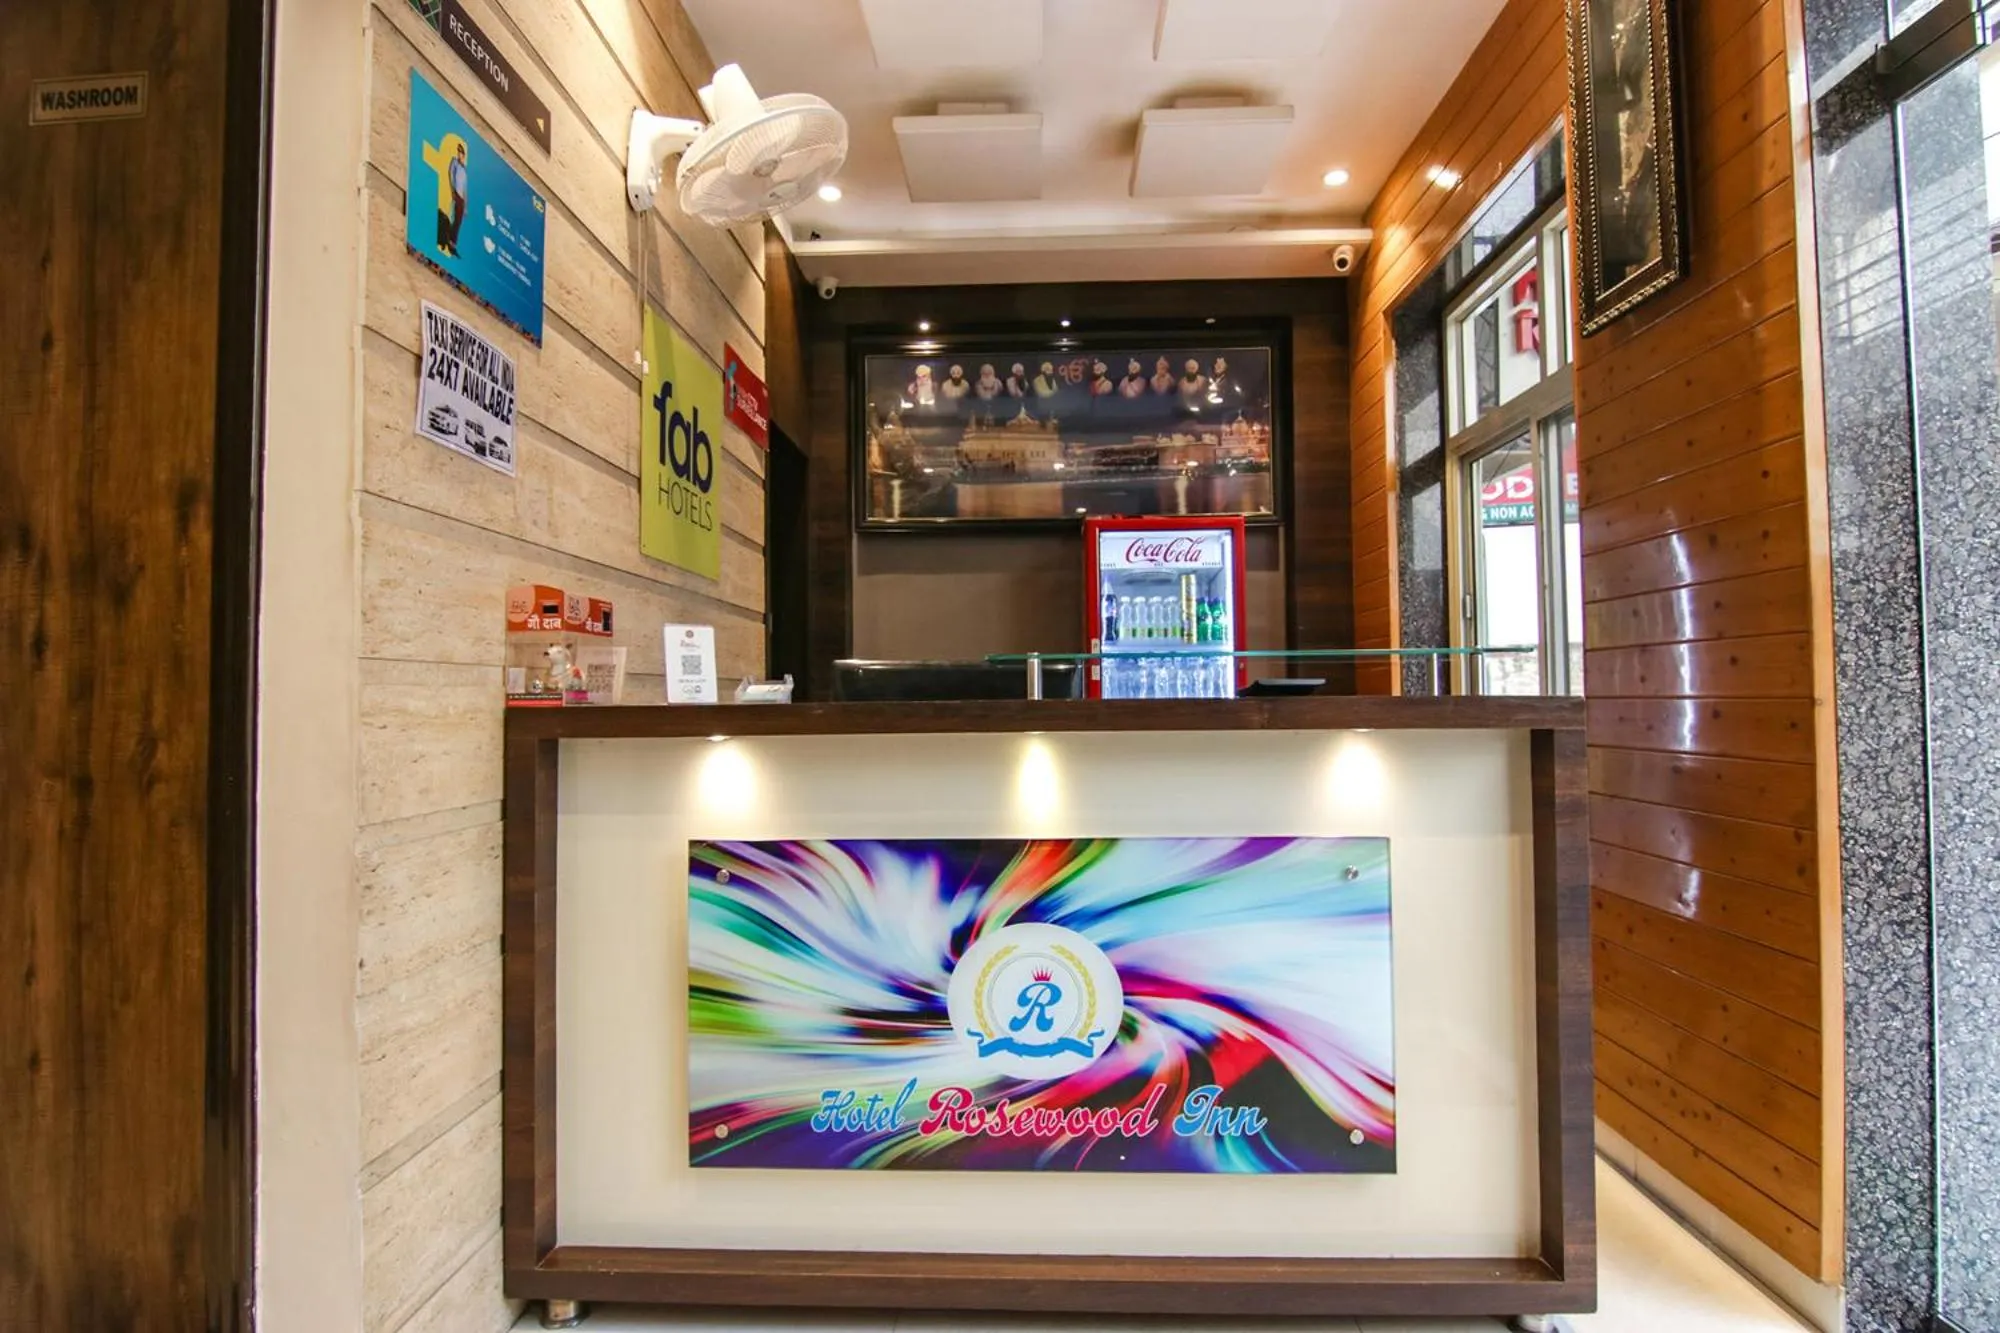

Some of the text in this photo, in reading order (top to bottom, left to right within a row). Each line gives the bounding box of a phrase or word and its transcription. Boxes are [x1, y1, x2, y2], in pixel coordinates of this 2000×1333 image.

[449, 13, 509, 92] RECEPTION
[42, 85, 138, 112] WASHROOM
[427, 311, 449, 351] TAXI
[450, 322, 477, 369] SERVICE
[475, 341, 489, 378] FOR
[427, 347, 514, 426] 24X7 AVAILABLE
[653, 381, 713, 493] fab
[658, 472, 712, 532] HOTELS
[1490, 506, 1517, 519] NON
[811, 1077, 1267, 1138] Hotel Rosewood Inn
